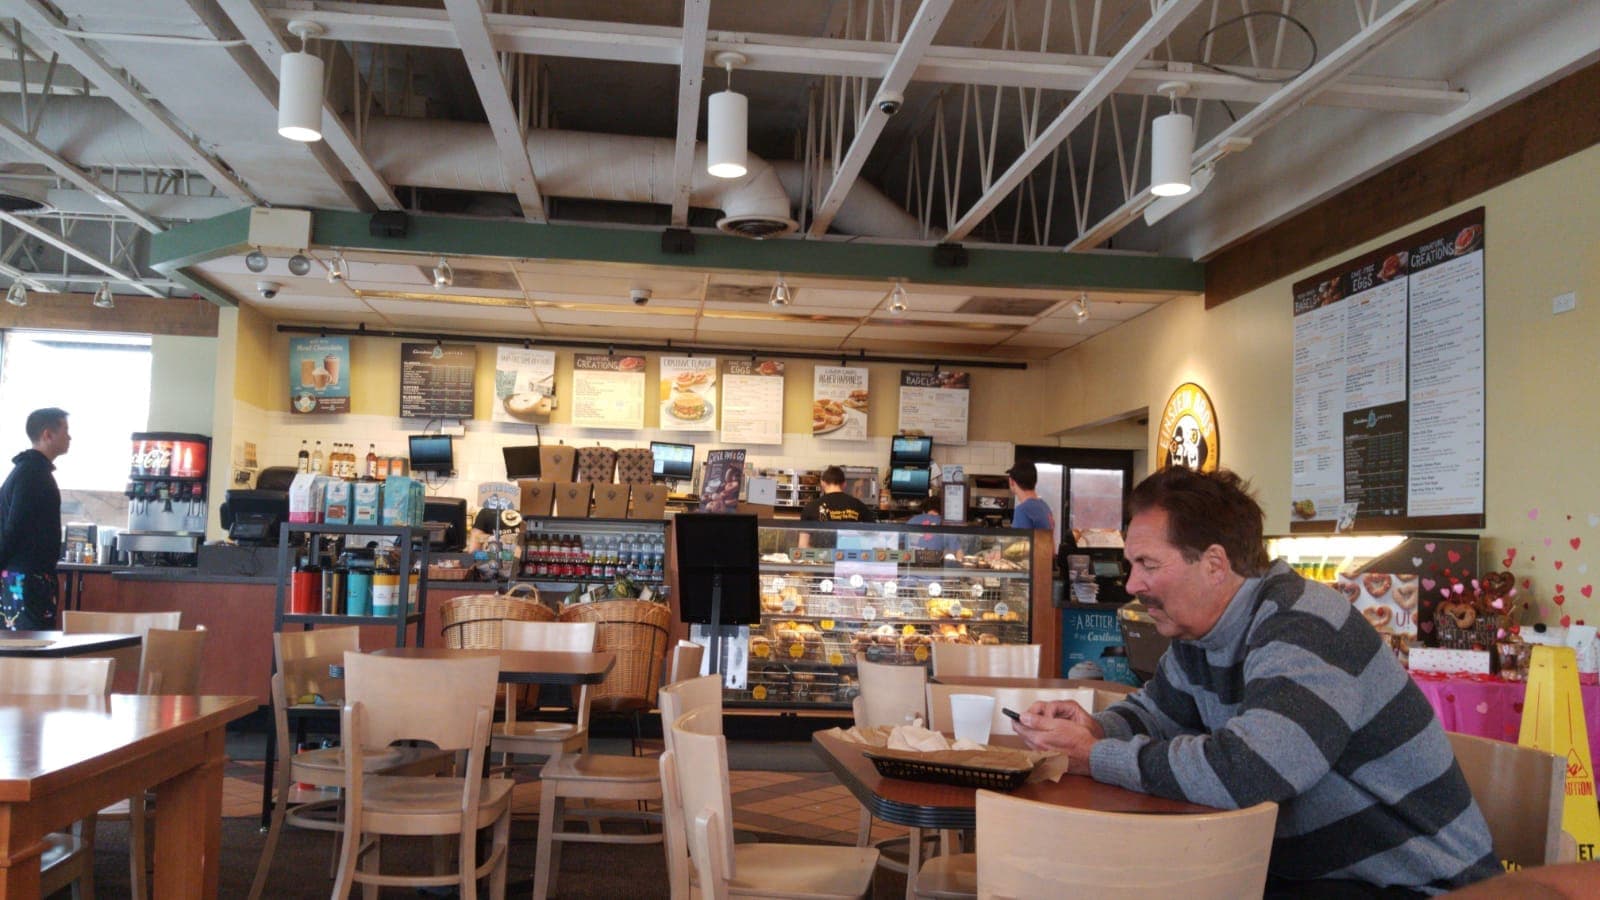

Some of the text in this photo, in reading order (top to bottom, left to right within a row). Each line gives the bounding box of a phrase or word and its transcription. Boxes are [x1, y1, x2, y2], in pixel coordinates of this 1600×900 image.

[1411, 242, 1454, 267] CREATIONS
[1352, 273, 1373, 292] EGGS
[577, 358, 618, 369] CREATIONS
[730, 366, 751, 374] EGGS
[1075, 615, 1084, 631] A
[1085, 615, 1113, 630] BETTER
[1565, 781, 1593, 796] UTION
[1579, 844, 1595, 861] ET
